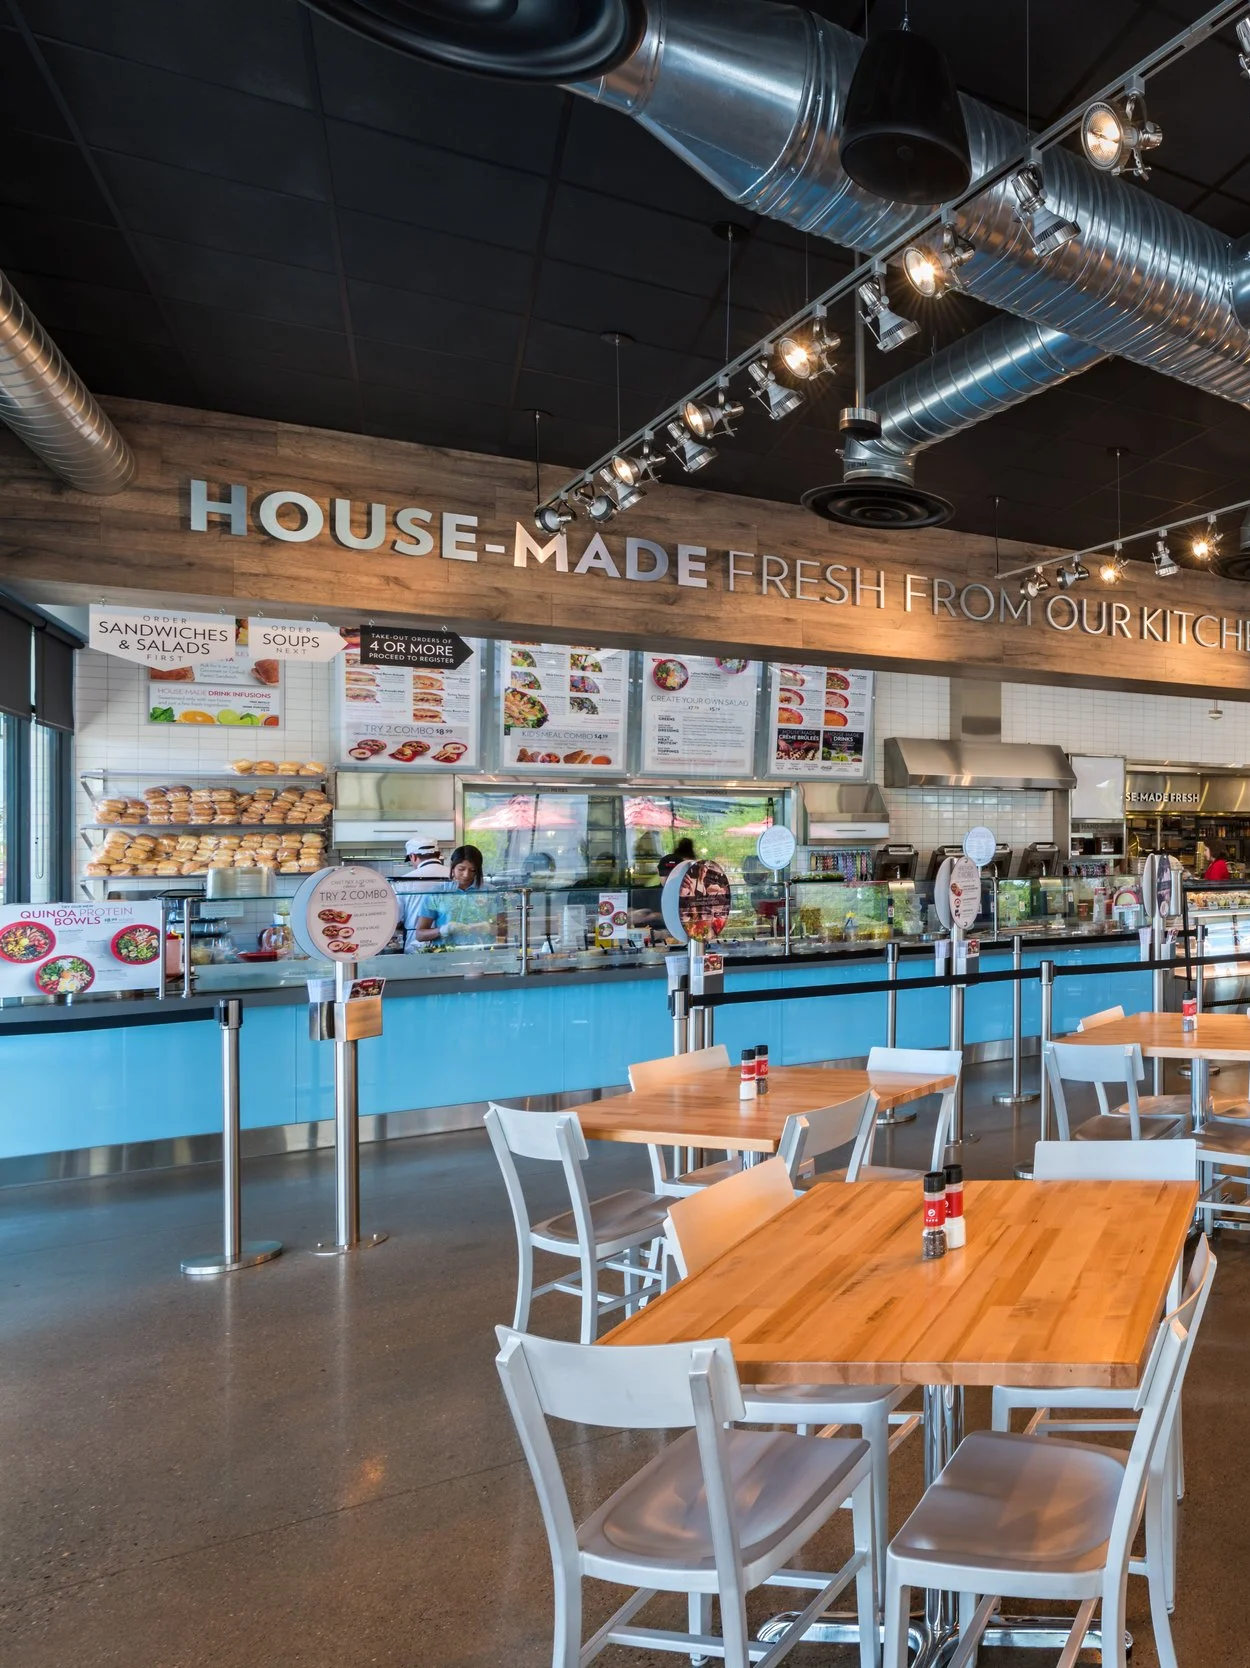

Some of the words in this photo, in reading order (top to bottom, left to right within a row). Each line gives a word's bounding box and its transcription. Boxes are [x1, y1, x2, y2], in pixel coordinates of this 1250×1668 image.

[191, 479, 708, 589] HOUSE-MADE
[728, 550, 885, 609] FRESH
[905, 573, 1032, 626] FROM
[1046, 594, 1133, 639] OUR
[142, 615, 187, 624] ORDER
[98, 621, 228, 642] SANDWICHES
[271, 625, 312, 633] ORDER
[262, 633, 320, 648] SOUPS
[371, 633, 409, 641] TAKE-OUT
[118, 640, 130, 650] &
[136, 638, 210, 655] SALADS
[369, 640, 380, 651] 4
[383, 641, 406, 653] OR
[410, 643, 453, 657] MORE
[146, 654, 184, 662] FIRST
[369, 652, 404, 661] PROCEED
[419, 656, 454, 664] REGISTER
[208, 690, 232, 698] DRINK
[232, 691, 271, 699] INFUSIONS
[650, 695, 679, 703] CREATE
[725, 699, 749, 707] SALAD
[364, 725, 383, 733] TRY
[384, 726, 392, 734] 2
[394, 726, 434, 735] COMBO
[1170, 793, 1200, 803] FRESH
[320, 892, 338, 901] TRY
[341, 891, 347, 900] 2
[349, 889, 388, 900] COMBO
[20, 909, 77, 919] QUINOA
[79, 907, 133, 918] PROTEIN
[54, 916, 101, 927] BOWLS
